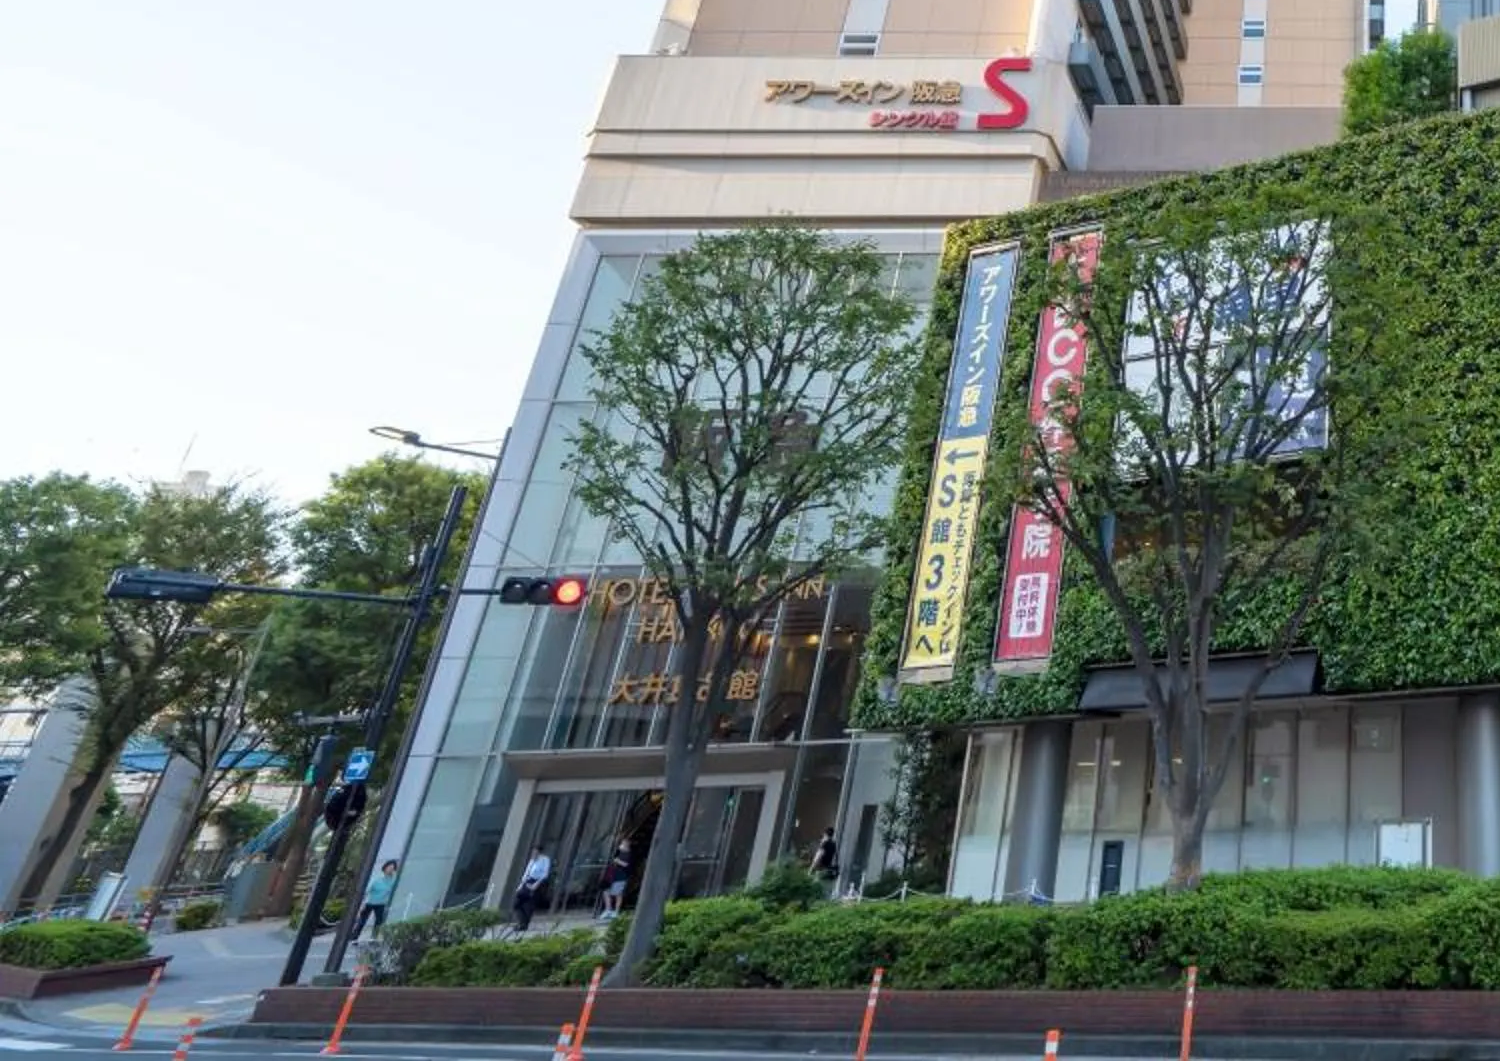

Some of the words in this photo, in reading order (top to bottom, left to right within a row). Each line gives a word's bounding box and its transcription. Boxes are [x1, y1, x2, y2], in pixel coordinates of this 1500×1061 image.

[765, 80, 902, 104] アワーズイン
[909, 80, 962, 104] 阪急
[976, 57, 1032, 130] S
[957, 266, 1002, 428] アワーズイン阪急
[905, 473, 958, 654] S館3階へ
[608, 668, 760, 704] 大井館
